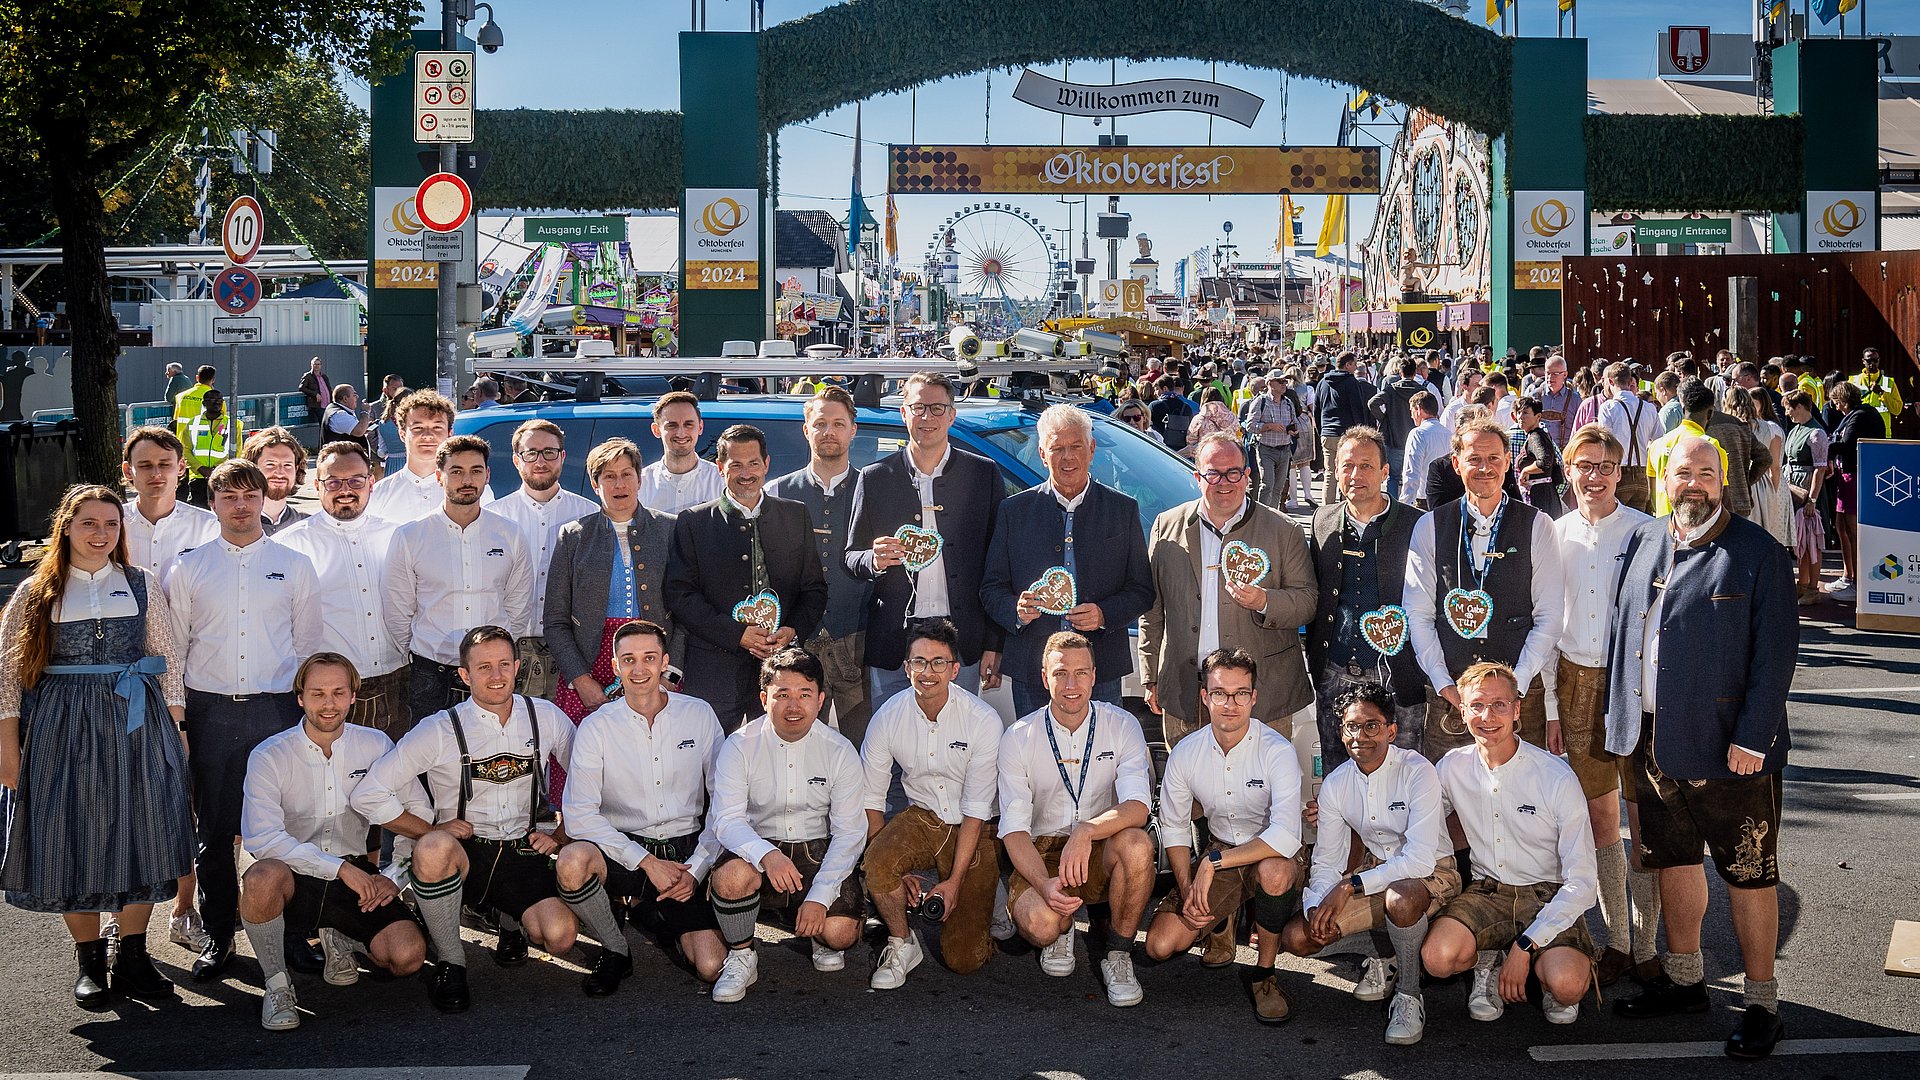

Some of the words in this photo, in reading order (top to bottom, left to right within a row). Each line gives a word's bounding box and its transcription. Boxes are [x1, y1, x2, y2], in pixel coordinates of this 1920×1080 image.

[1676, 58, 1684, 66] G
[1694, 58, 1702, 66] S
[1056, 88, 1176, 110] Willkommen
[1182, 90, 1220, 108] zum
[1038, 150, 1234, 190] Oktoberfest
[234, 216, 253, 246] 10
[538, 226, 582, 236] Ausgang
[584, 226, 588, 234] /
[590, 225, 609, 234] Exit
[1640, 227, 1677, 238] Eingang
[1680, 227, 1684, 236] /
[1686, 227, 1727, 236] Entrance
[698, 238, 744, 248] Oktoberfest
[1526, 240, 1571, 249] Oktoberfest
[1818, 240, 1862, 248] Oktoberfest
[390, 266, 435, 282] 2024
[701, 267, 745, 282] 2024
[1530, 267, 1561, 283] 202
[218, 327, 257, 336] Rettungsweg
[1146, 322, 1194, 340] Information
[904, 537, 914, 546] M
[904, 550, 924, 563] TUM
[1230, 554, 1240, 563] M
[1228, 569, 1250, 582] TUM
[1040, 592, 1050, 602] M
[1052, 592, 1072, 609] TUM
[1888, 594, 1903, 603] TUM
[1455, 604, 1464, 613] M
[744, 613, 754, 623] M
[757, 618, 775, 629] UM
[1456, 618, 1476, 628] TUM
[1371, 623, 1382, 636] M
[1382, 618, 1402, 630] Cube
[1377, 634, 1400, 648] TUM
